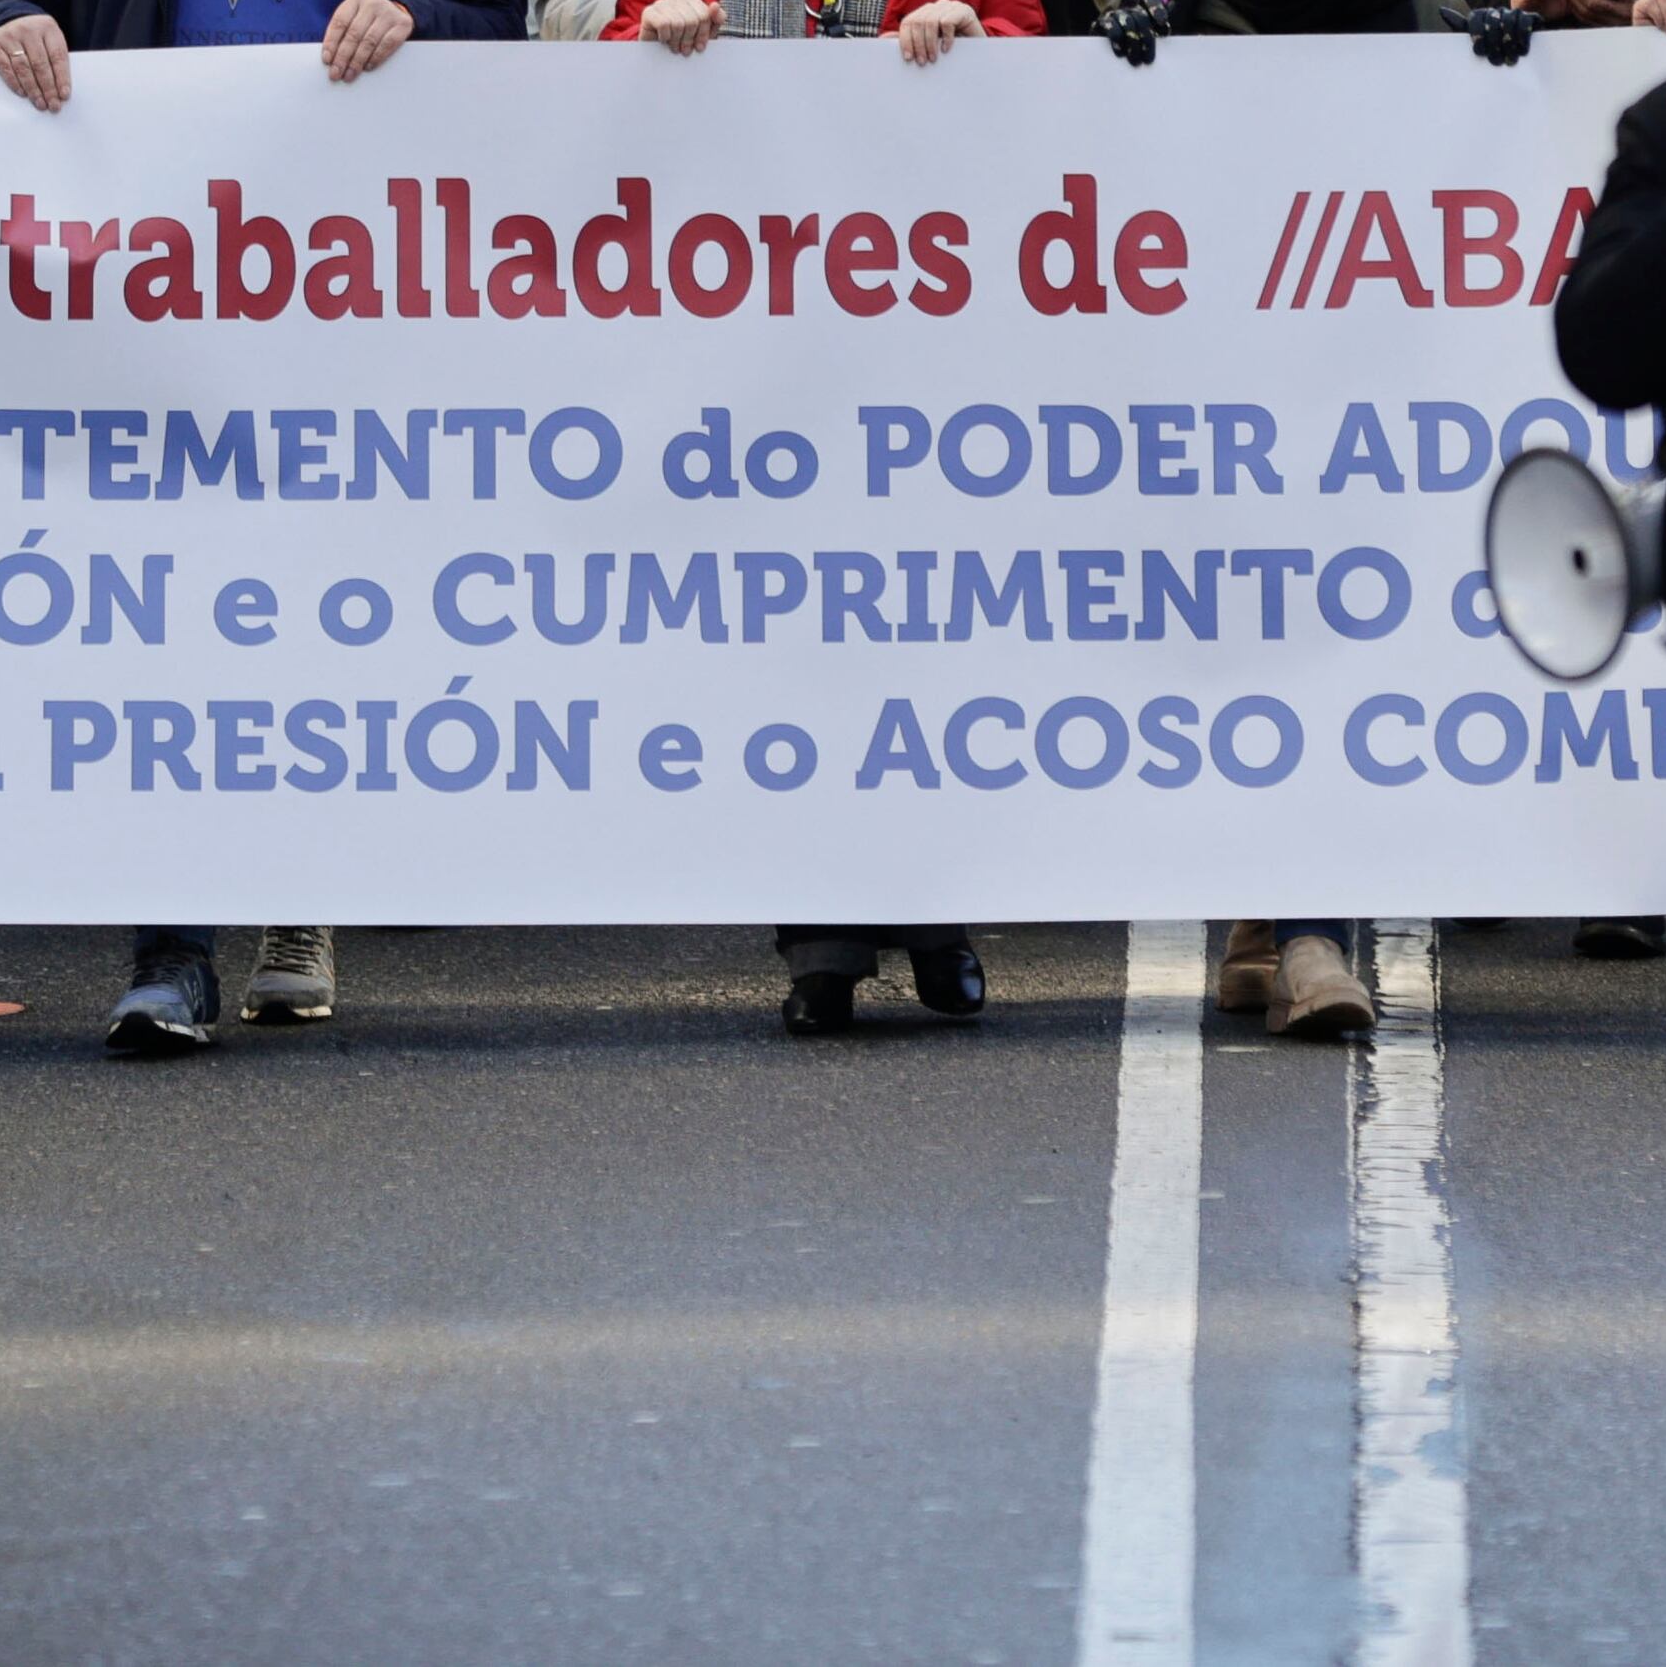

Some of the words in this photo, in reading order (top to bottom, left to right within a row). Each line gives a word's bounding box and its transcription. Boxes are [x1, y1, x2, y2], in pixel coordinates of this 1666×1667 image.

[0, 176, 972, 322] traballadores
[1018, 173, 1188, 317] de
[661, 406, 820, 501] do
[858, 403, 1285, 498] PODER
[213, 577, 279, 647] e
[318, 577, 394, 647] o
[432, 545, 1412, 646] CUMPRIMENTO
[42, 675, 599, 793] PRESIÓN
[638, 723, 703, 792] e
[743, 722, 819, 792] o
[855, 694, 1304, 791] ACOSO
